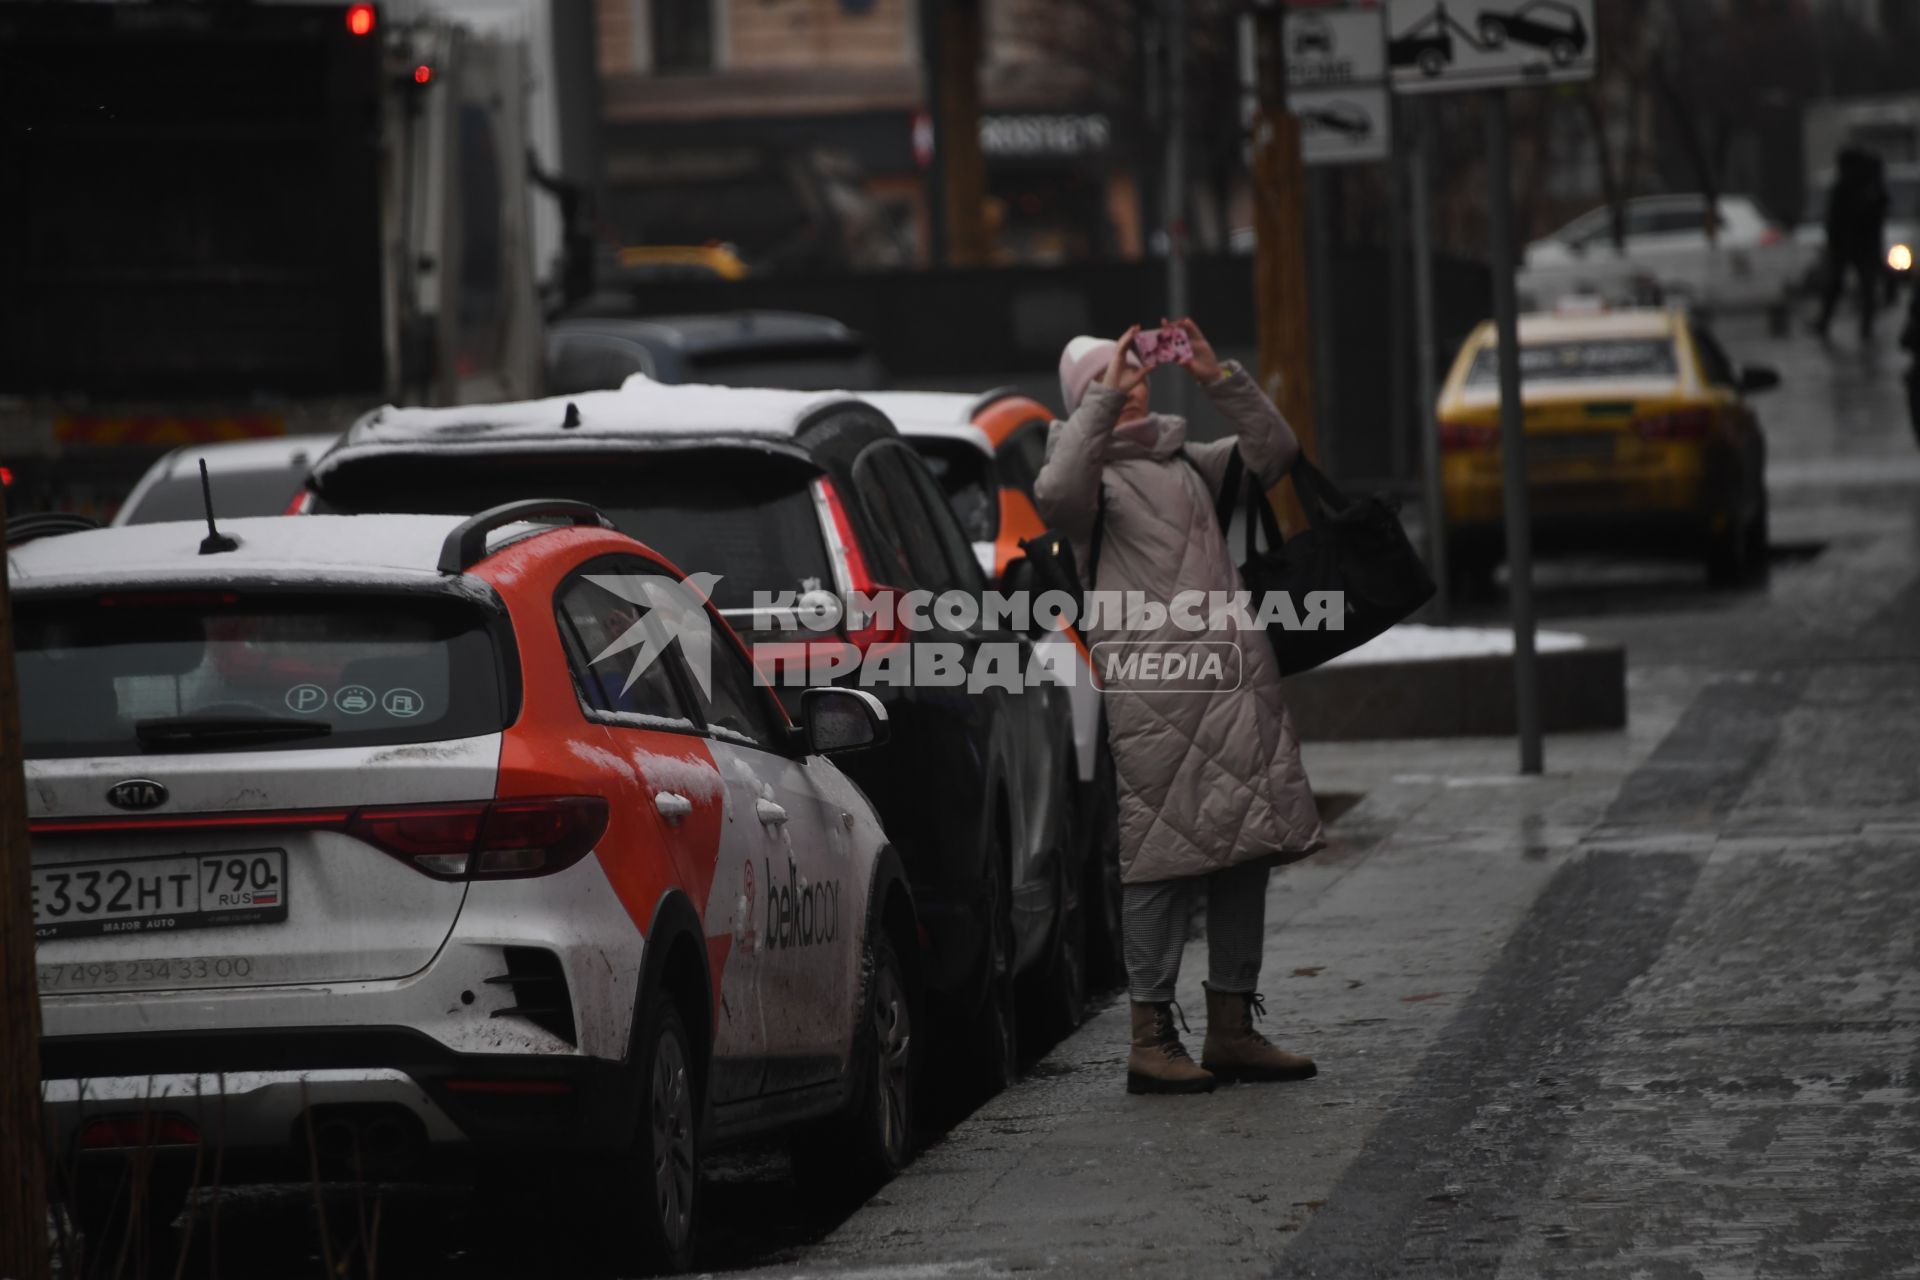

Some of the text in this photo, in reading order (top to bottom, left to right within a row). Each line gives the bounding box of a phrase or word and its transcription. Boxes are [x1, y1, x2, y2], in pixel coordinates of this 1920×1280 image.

[115, 787, 159, 805] KIA
[203, 857, 271, 893] 790
[219, 893, 252, 905] RUS
[103, 918, 175, 932] MAJOR AUTO
[40, 958, 251, 985] +7 495 234 33 00
